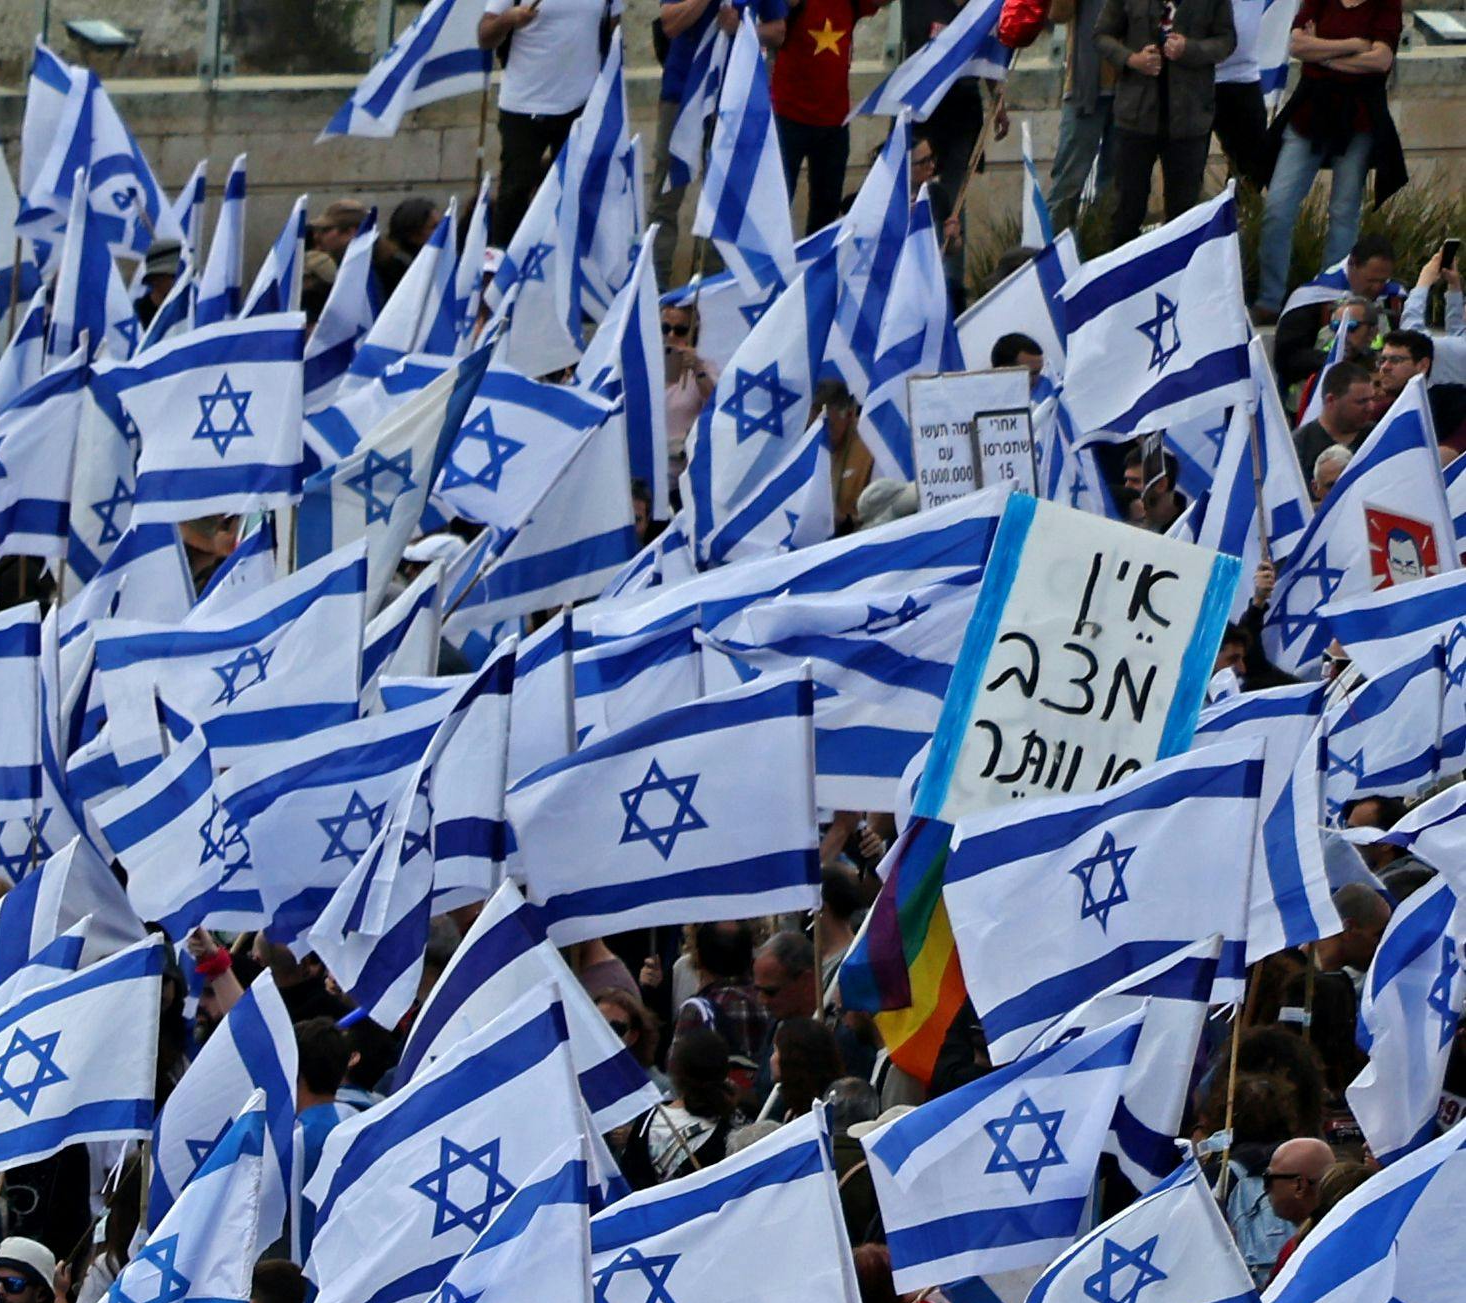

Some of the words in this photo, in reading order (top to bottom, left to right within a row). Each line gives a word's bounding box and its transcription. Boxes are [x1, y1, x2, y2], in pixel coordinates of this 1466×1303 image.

[990, 416, 1017, 432] אחרי
[938, 446, 953, 460] עם
[998, 463, 1014, 479] 15
